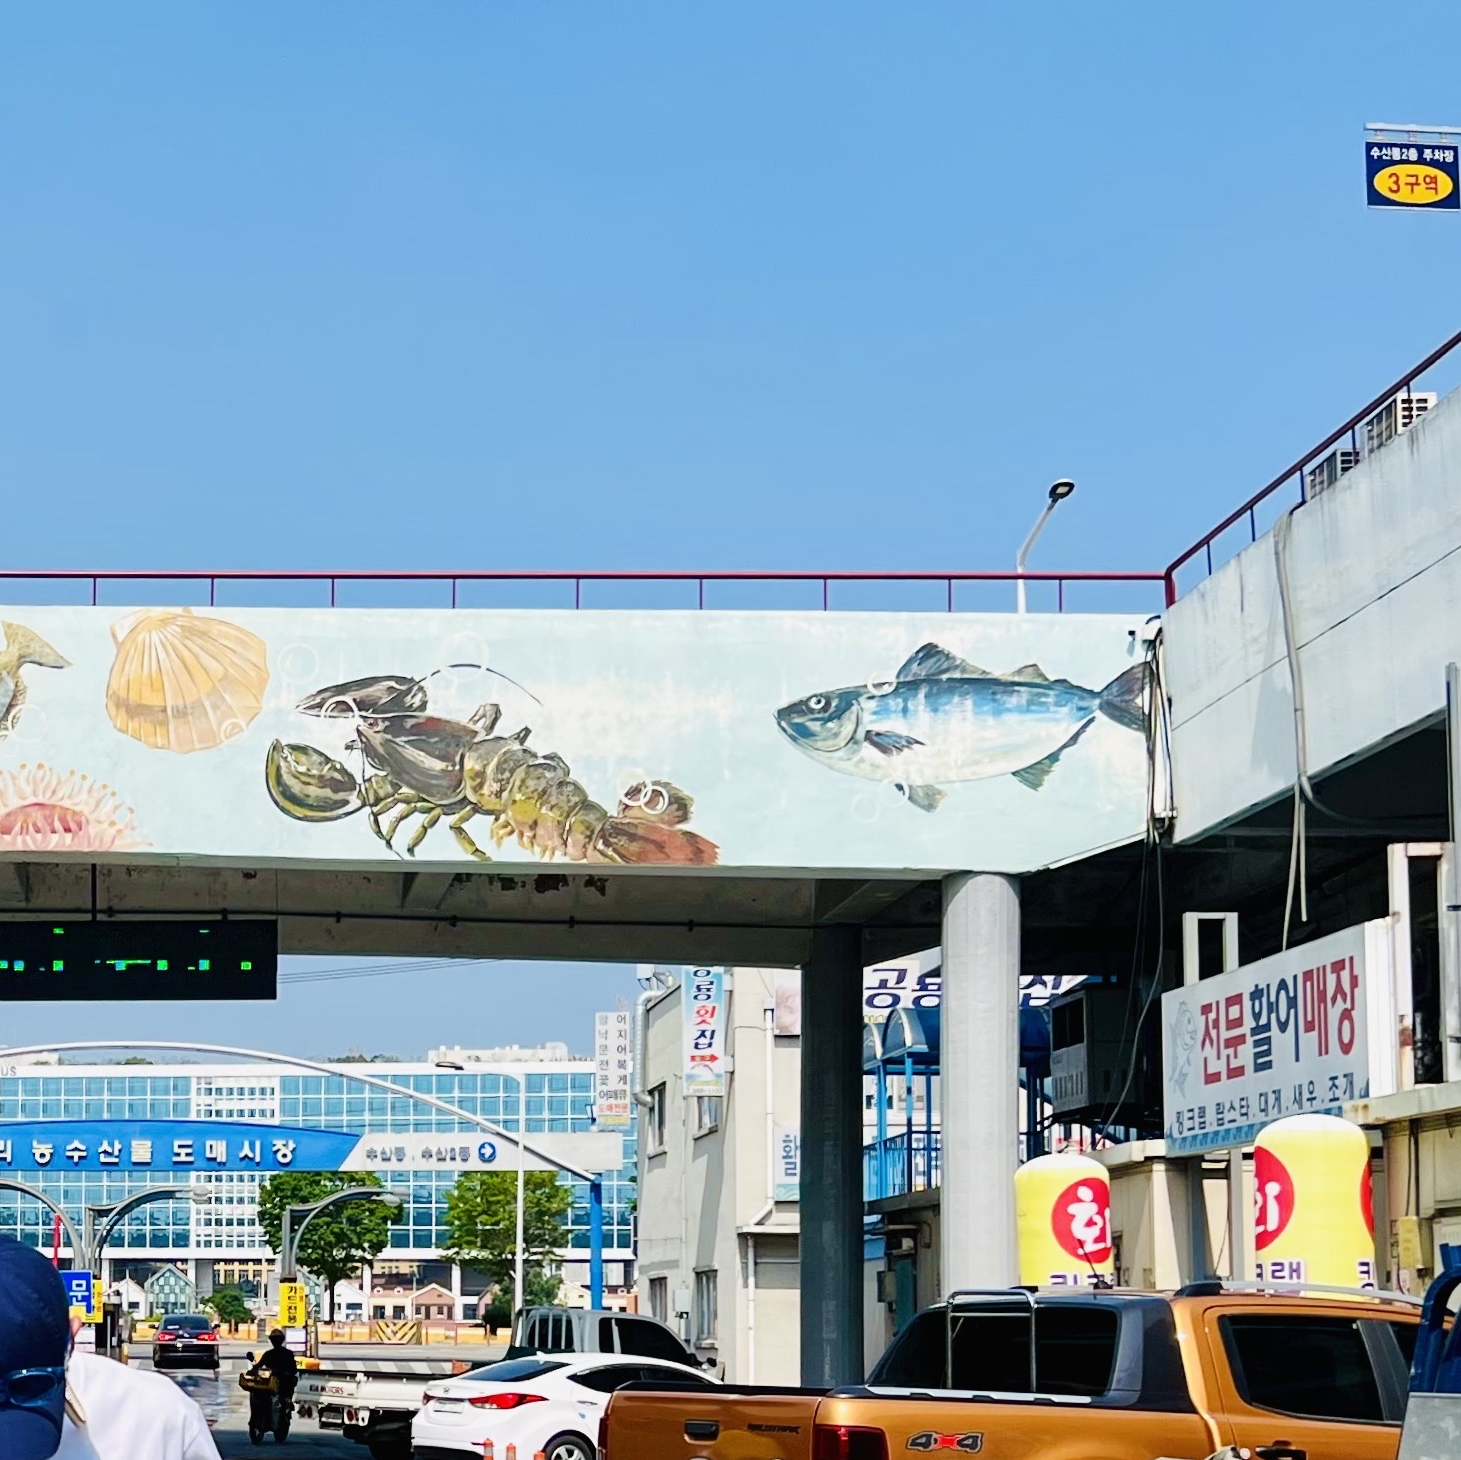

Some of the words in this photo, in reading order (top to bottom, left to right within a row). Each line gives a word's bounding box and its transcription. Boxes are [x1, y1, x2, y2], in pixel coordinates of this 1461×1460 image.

[1423, 148, 1454, 162] 주차장
[1328, 1072, 1355, 1103] 조개
[32, 1139, 153, 1164] 농수산물
[172, 1139, 297, 1165] 도매시장
[1067, 1186, 1111, 1255] 회
